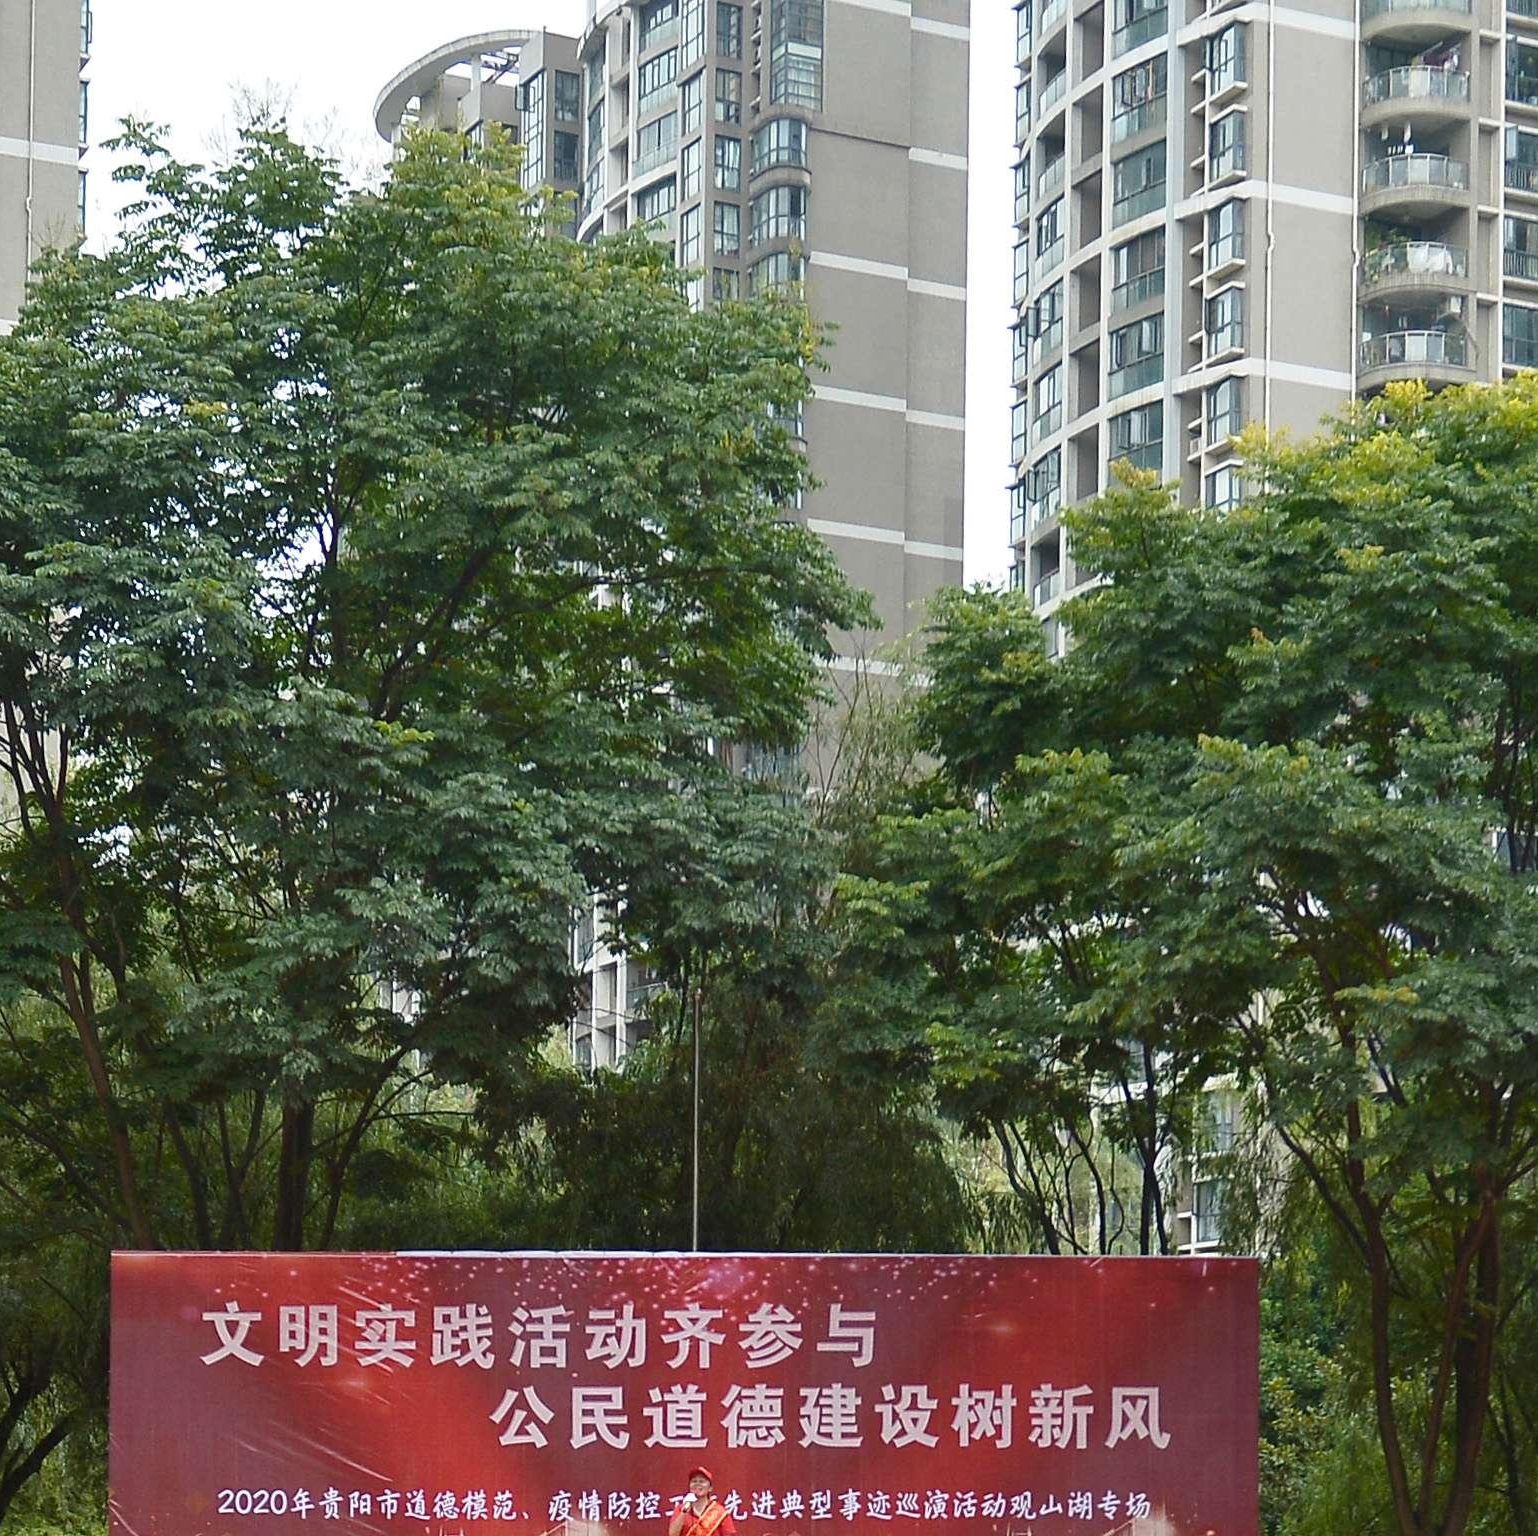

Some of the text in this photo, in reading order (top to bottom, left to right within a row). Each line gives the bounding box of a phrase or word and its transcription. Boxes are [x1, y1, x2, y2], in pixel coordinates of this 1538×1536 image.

[200, 1300, 877, 1369] 文明实践活动齐参与
[489, 1384, 1171, 1450] 公民道德建设树新风
[217, 1487, 1152, 1522] 2020年贵阳市道德模范、疫情防控工先进典型事迹巡演活动观山湖专场
